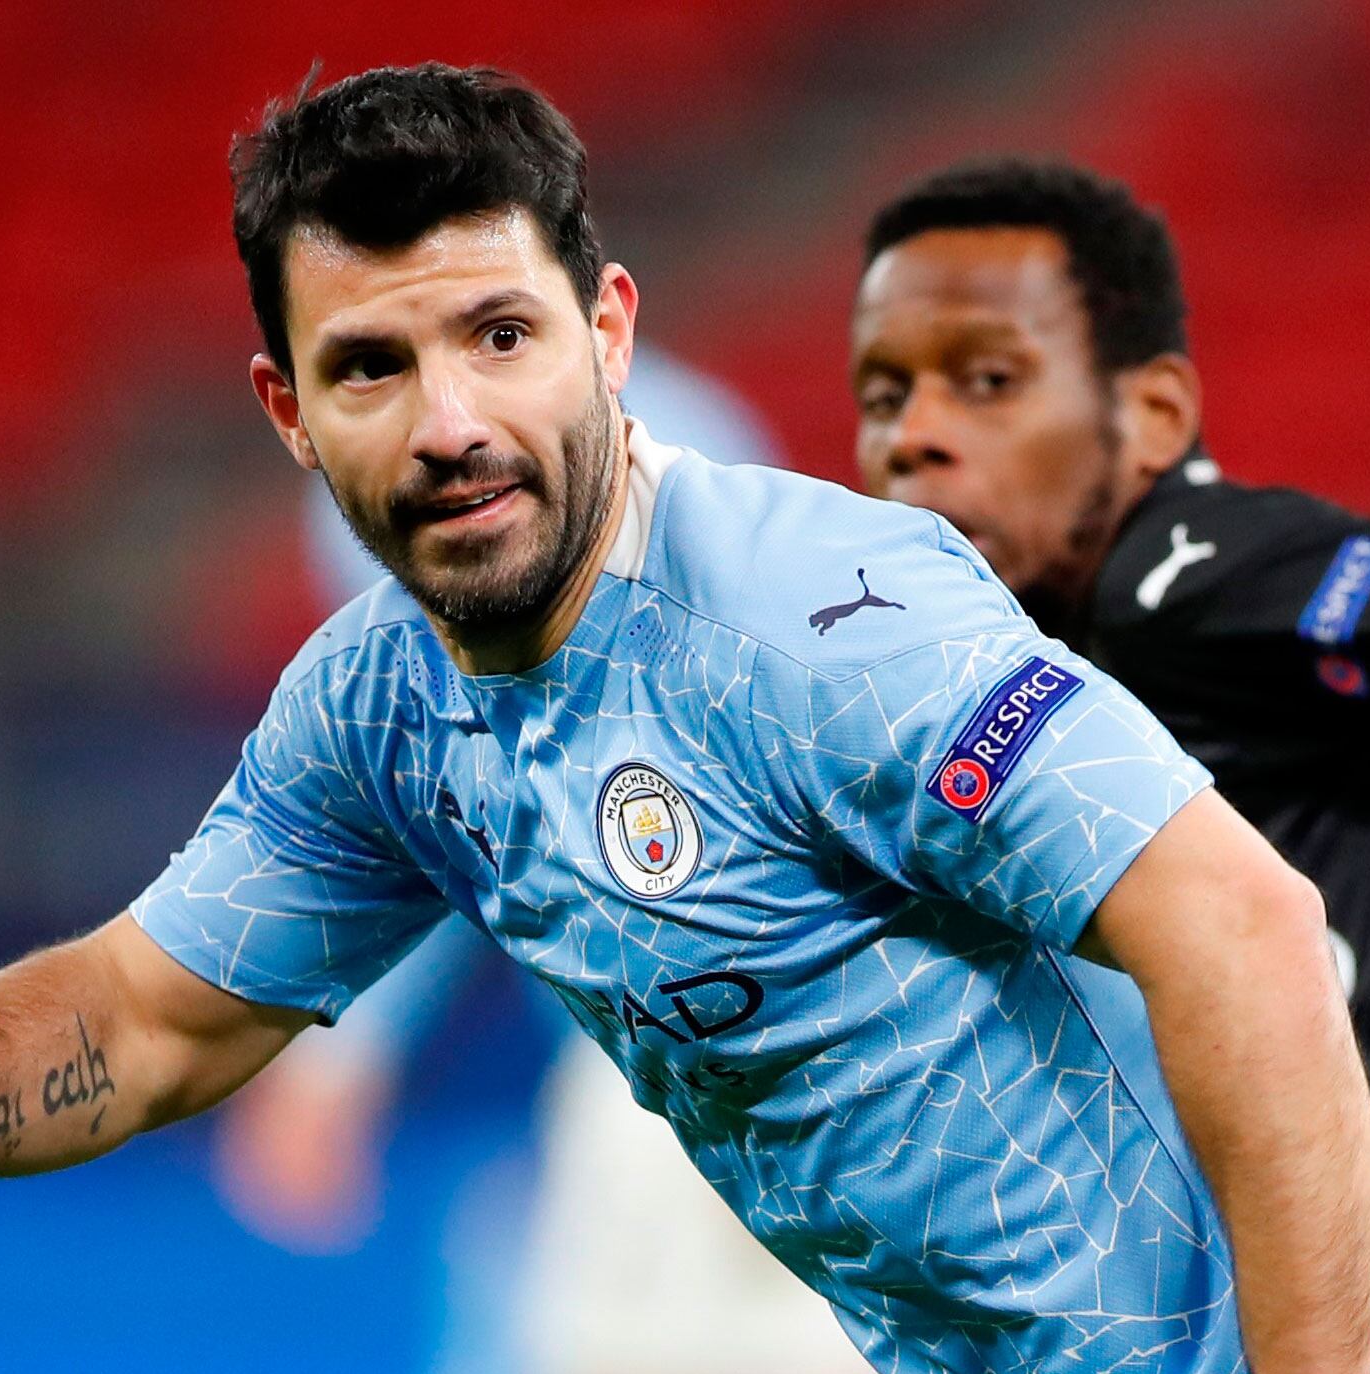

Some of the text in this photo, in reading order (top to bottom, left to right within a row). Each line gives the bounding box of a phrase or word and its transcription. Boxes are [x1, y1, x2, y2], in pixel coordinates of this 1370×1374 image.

[972, 663, 1067, 765] RESPECT
[942, 762, 964, 790] UEFA
[606, 772, 680, 821] MANCHESTER
[645, 874, 676, 891] CITY
